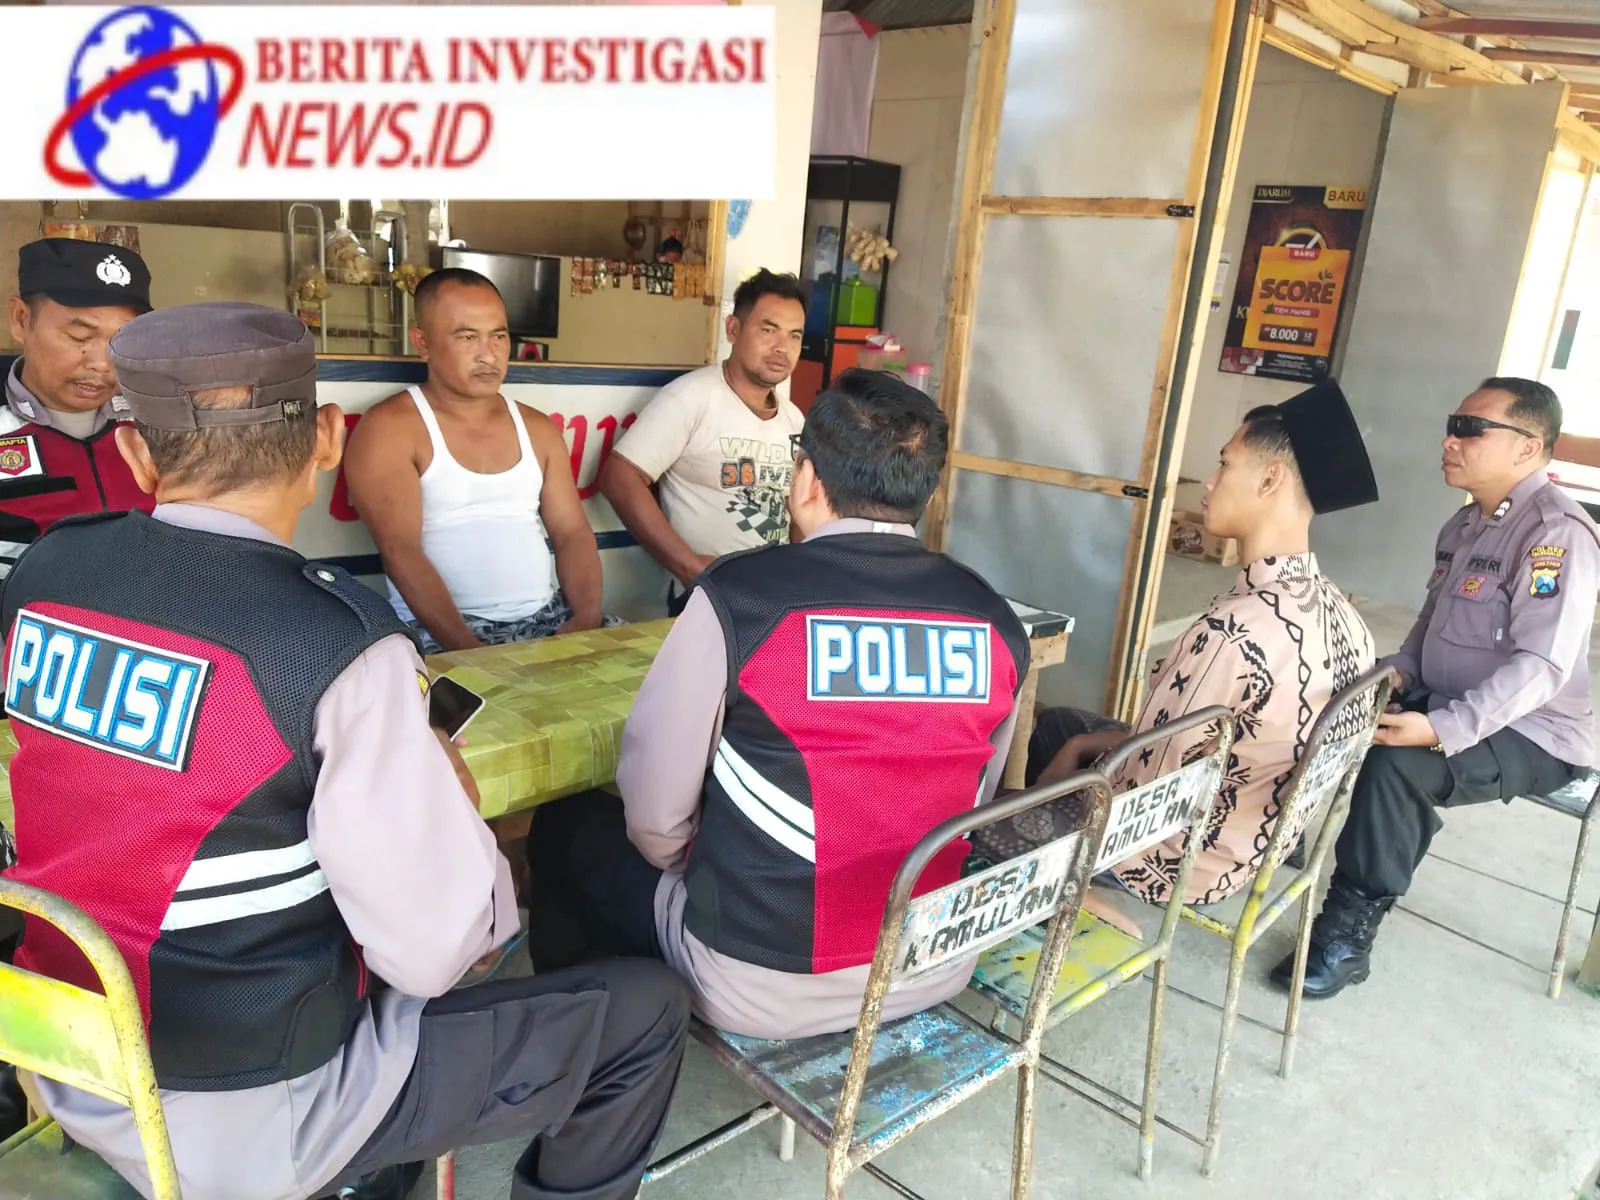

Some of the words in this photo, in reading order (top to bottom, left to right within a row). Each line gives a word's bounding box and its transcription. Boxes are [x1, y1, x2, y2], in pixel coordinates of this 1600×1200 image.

[1328, 190, 1367, 203] BARU
[1294, 250, 1315, 258] BARU
[1259, 278, 1336, 304] SCORE
[1270, 327, 1299, 341] 8.000
[720, 436, 786, 464] WILD
[813, 621, 987, 697] POLISI
[8, 618, 199, 761] POLISI
[1117, 777, 1181, 826] DESA
[950, 859, 1039, 920] DESA
